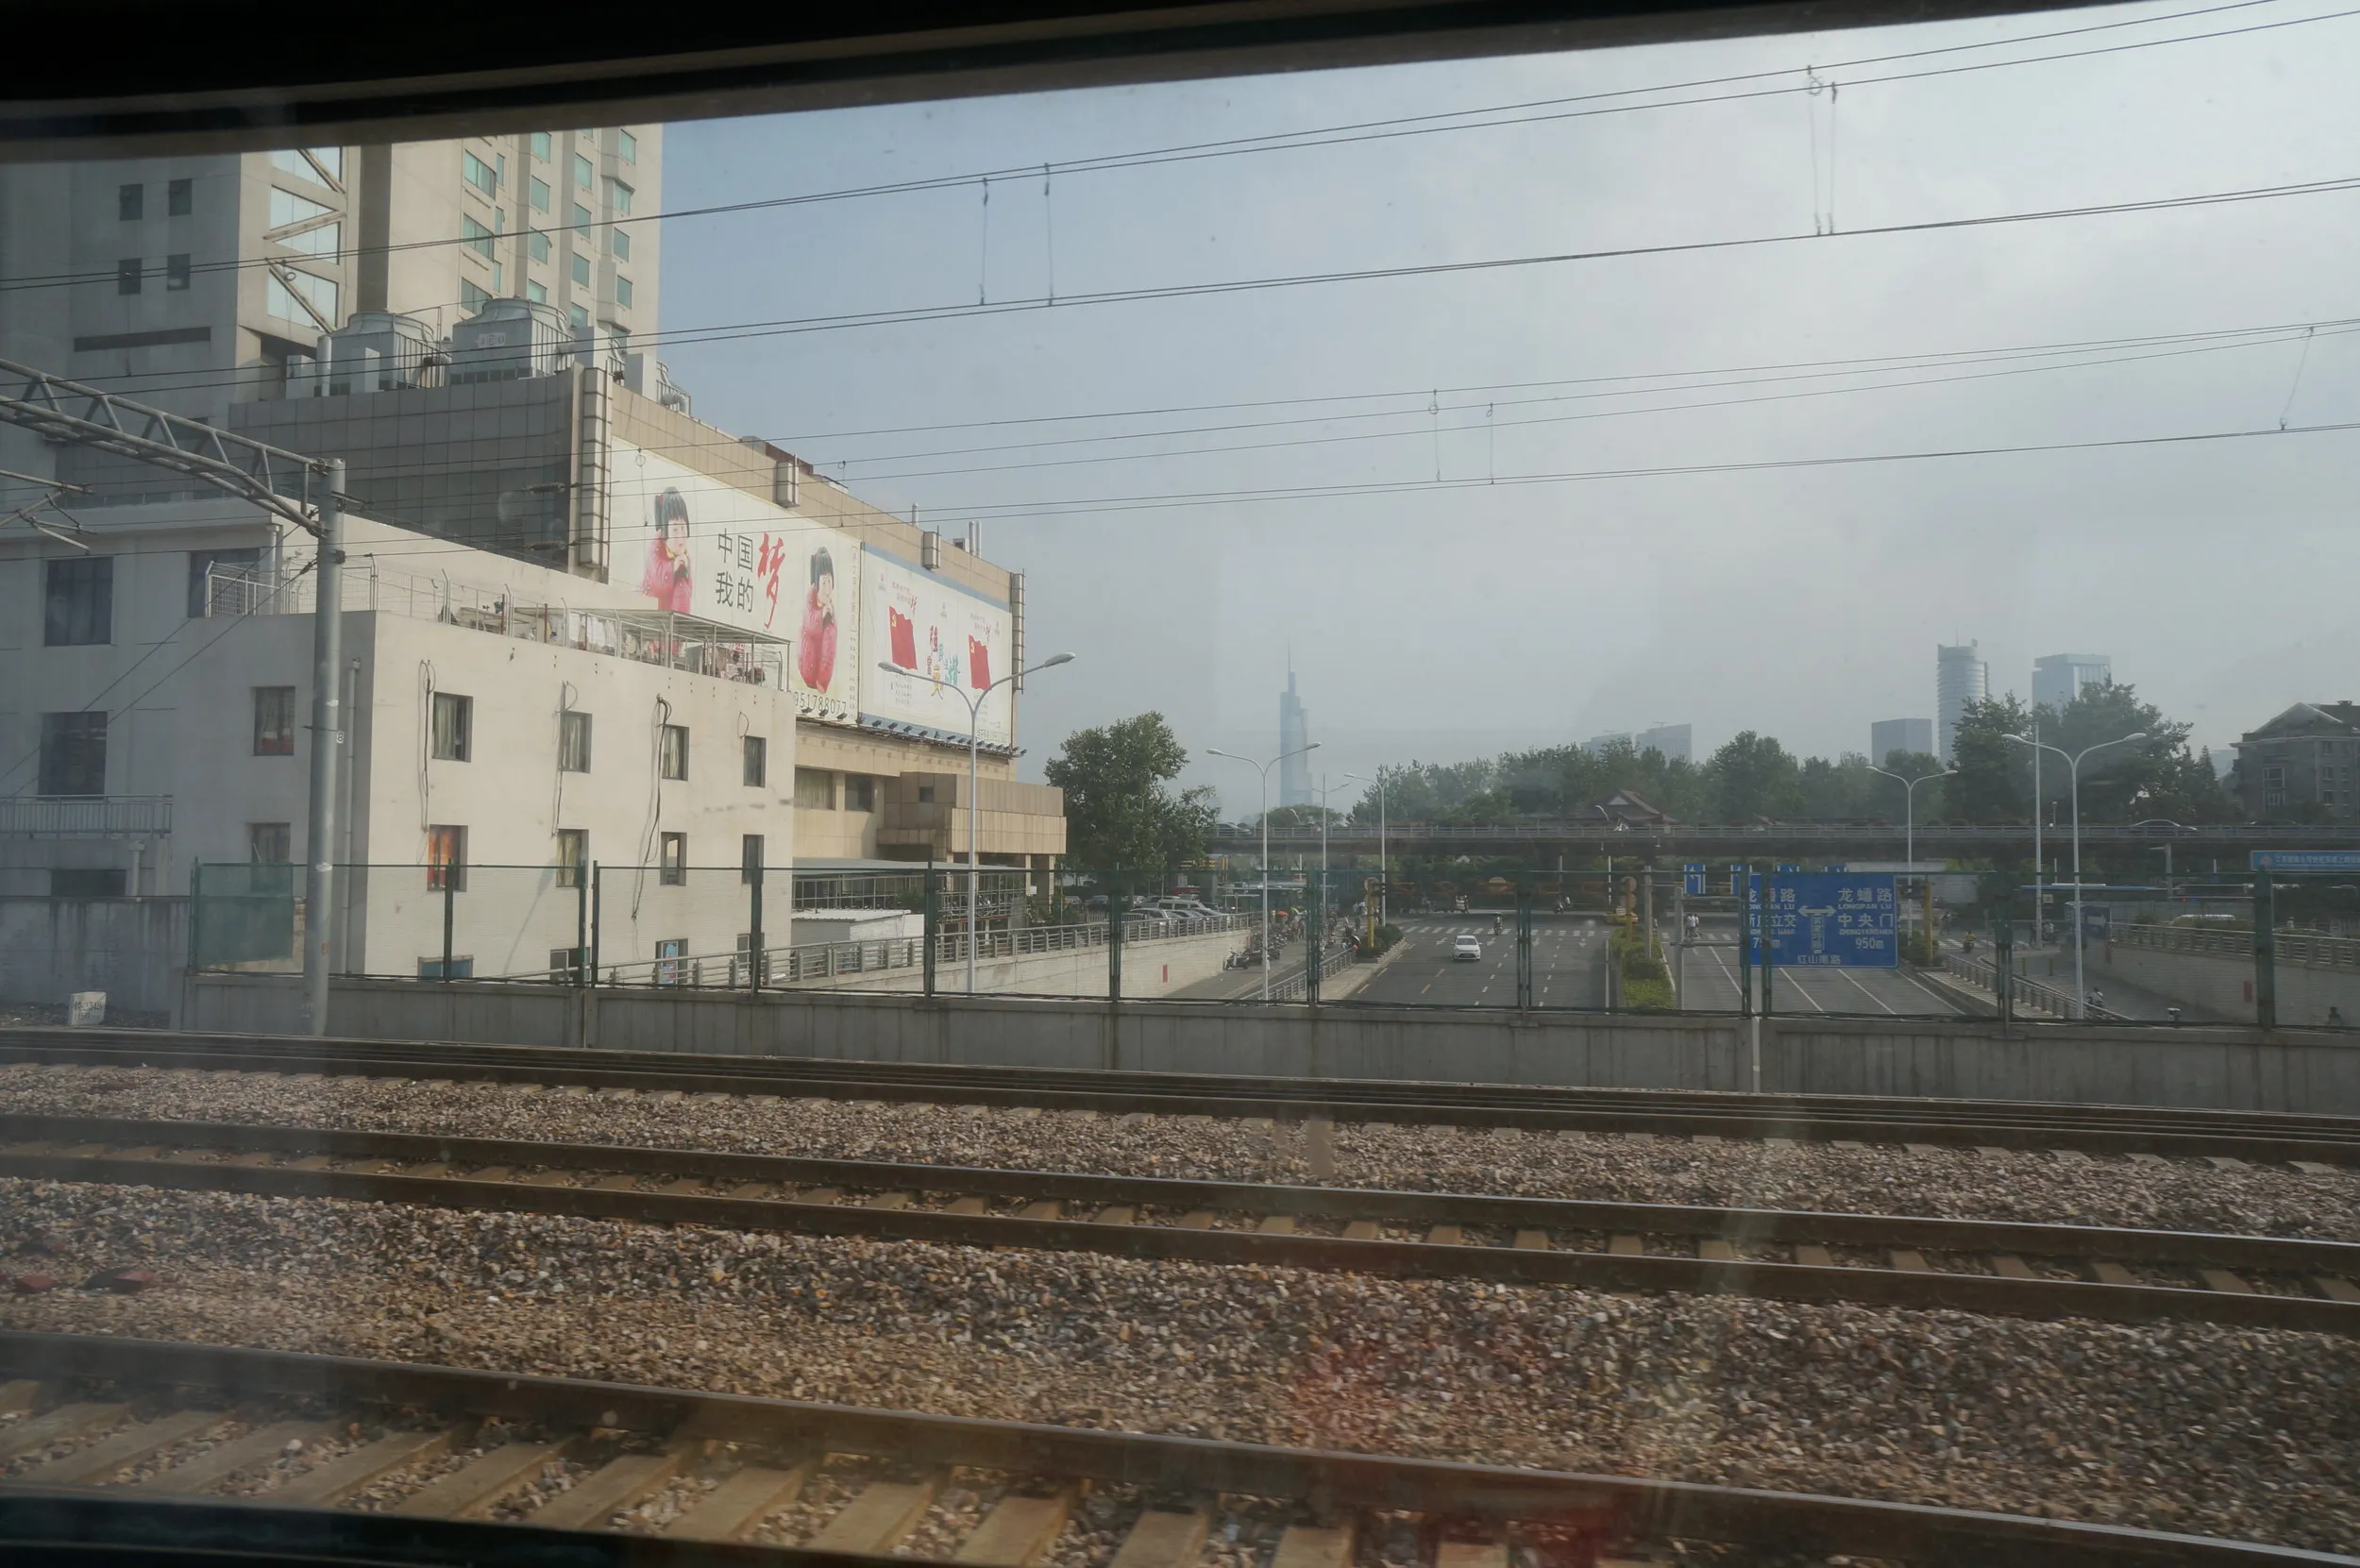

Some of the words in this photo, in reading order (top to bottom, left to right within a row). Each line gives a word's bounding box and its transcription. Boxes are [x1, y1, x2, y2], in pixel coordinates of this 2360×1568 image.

[717, 528, 753, 573] 中国
[715, 570, 754, 614] 我的
[757, 531, 785, 629] 梦
[1838, 887, 1893, 902] 龙蟠路
[1837, 913, 1894, 927] 中央门
[1855, 936, 1885, 950] 950m
